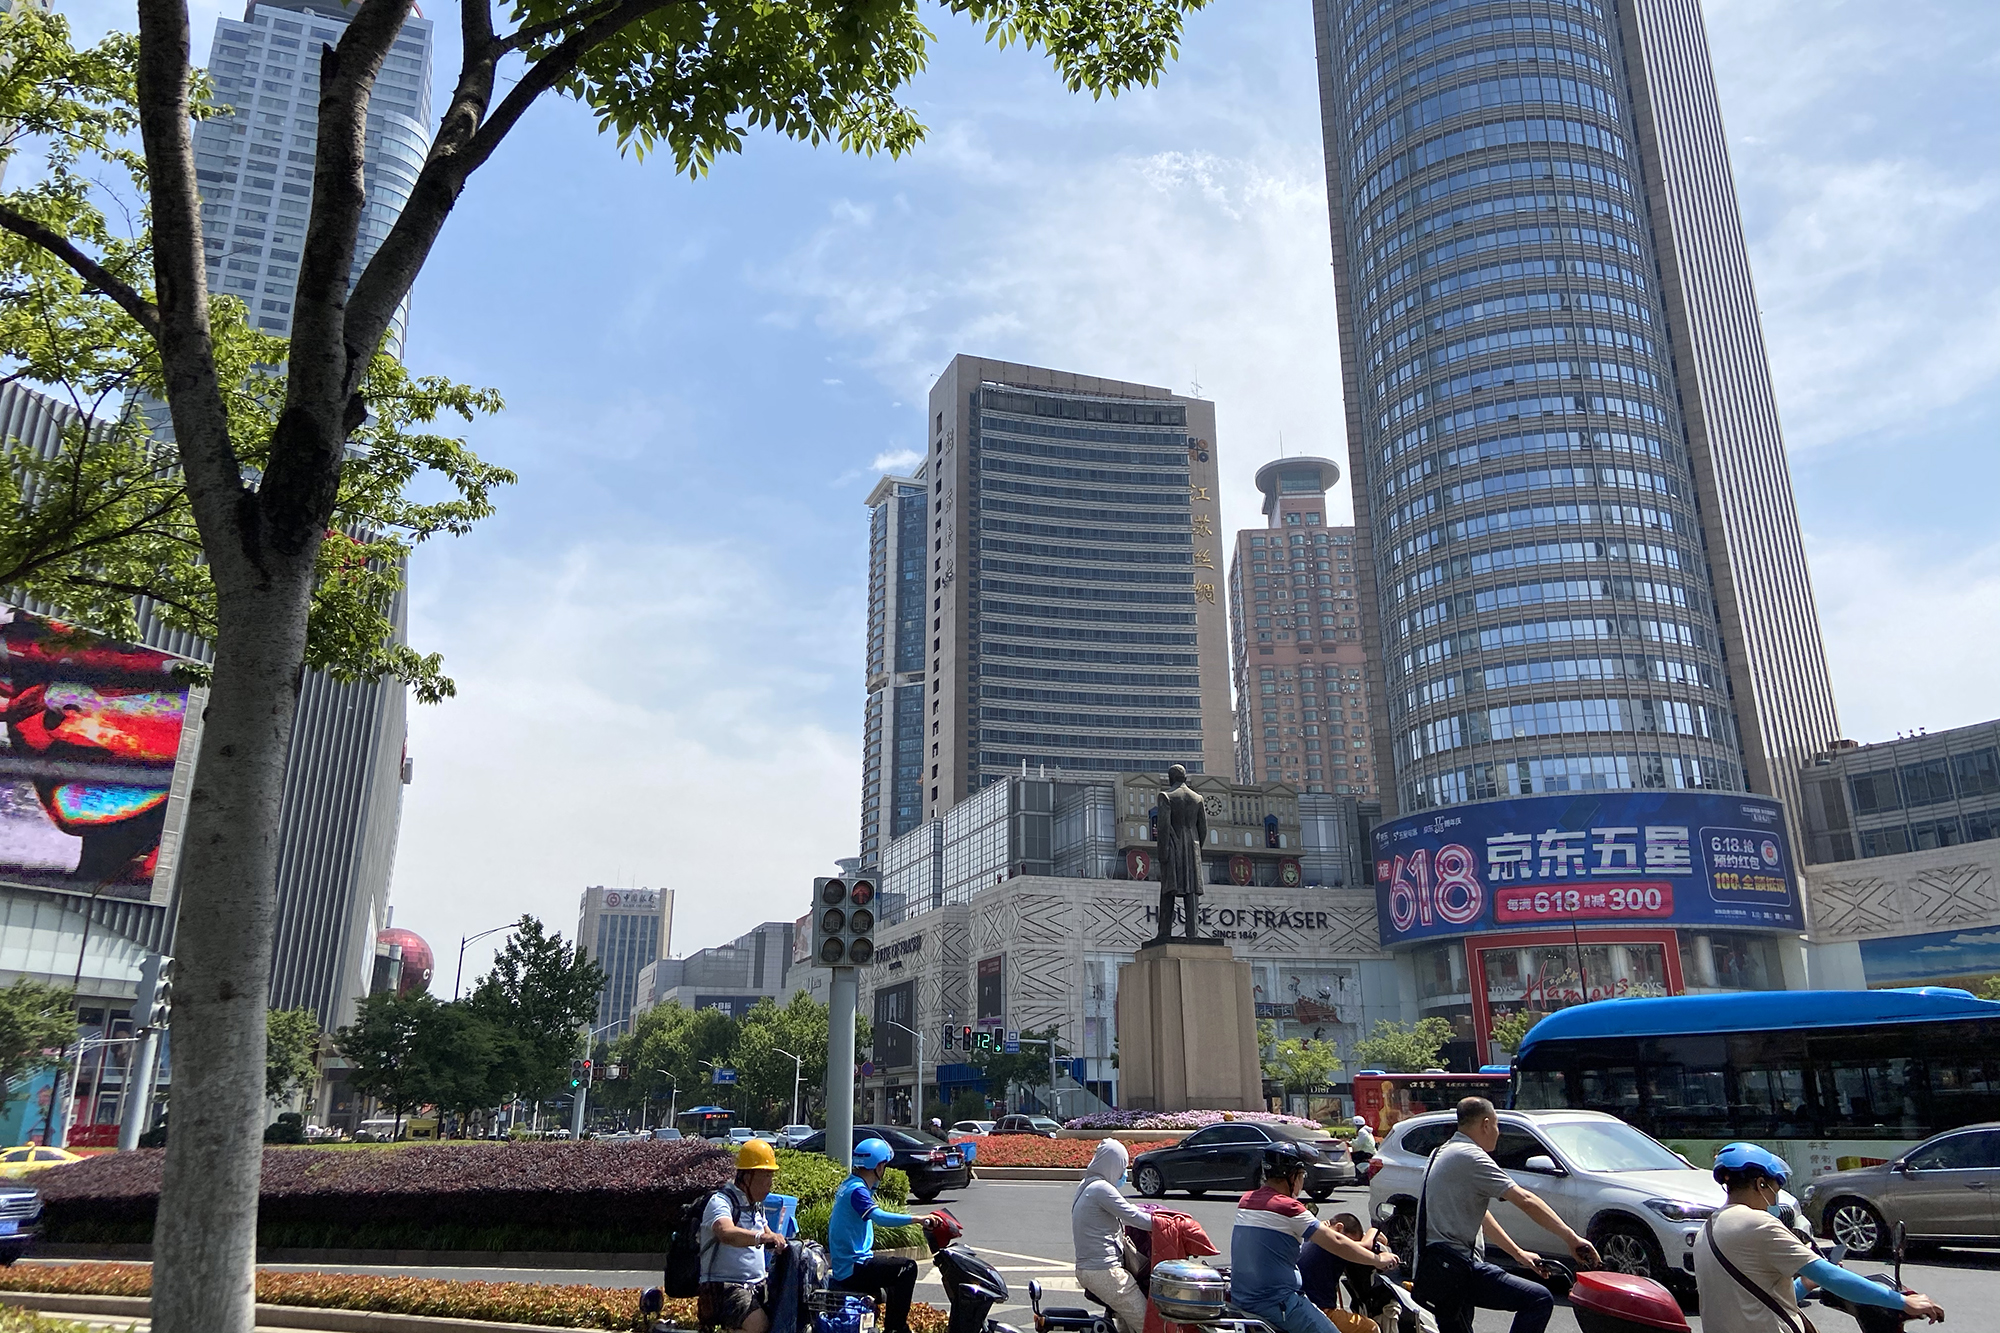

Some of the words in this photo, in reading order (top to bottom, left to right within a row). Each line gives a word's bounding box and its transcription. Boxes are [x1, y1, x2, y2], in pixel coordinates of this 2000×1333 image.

[1189, 484, 1215, 605] 江苏丝绸
[1487, 826, 1692, 881] 京东五星
[1714, 854, 1760, 870] 预约红包
[1390, 843, 1483, 932] 618
[1534, 890, 1581, 912] 618
[1609, 888, 1662, 910] 300
[1146, 905, 1212, 926] HUE
[1219, 908, 1246, 927] OF
[1254, 910, 1329, 929] FRASER
[1212, 930, 1236, 939] SINCE
[1239, 931, 1257, 940] 1849
[1490, 985, 1515, 996] TOYS
[1520, 960, 1629, 1011] Hamleys
[977, 1033, 990, 1049] 12
[1310, 1085, 1331, 1093] Dior
